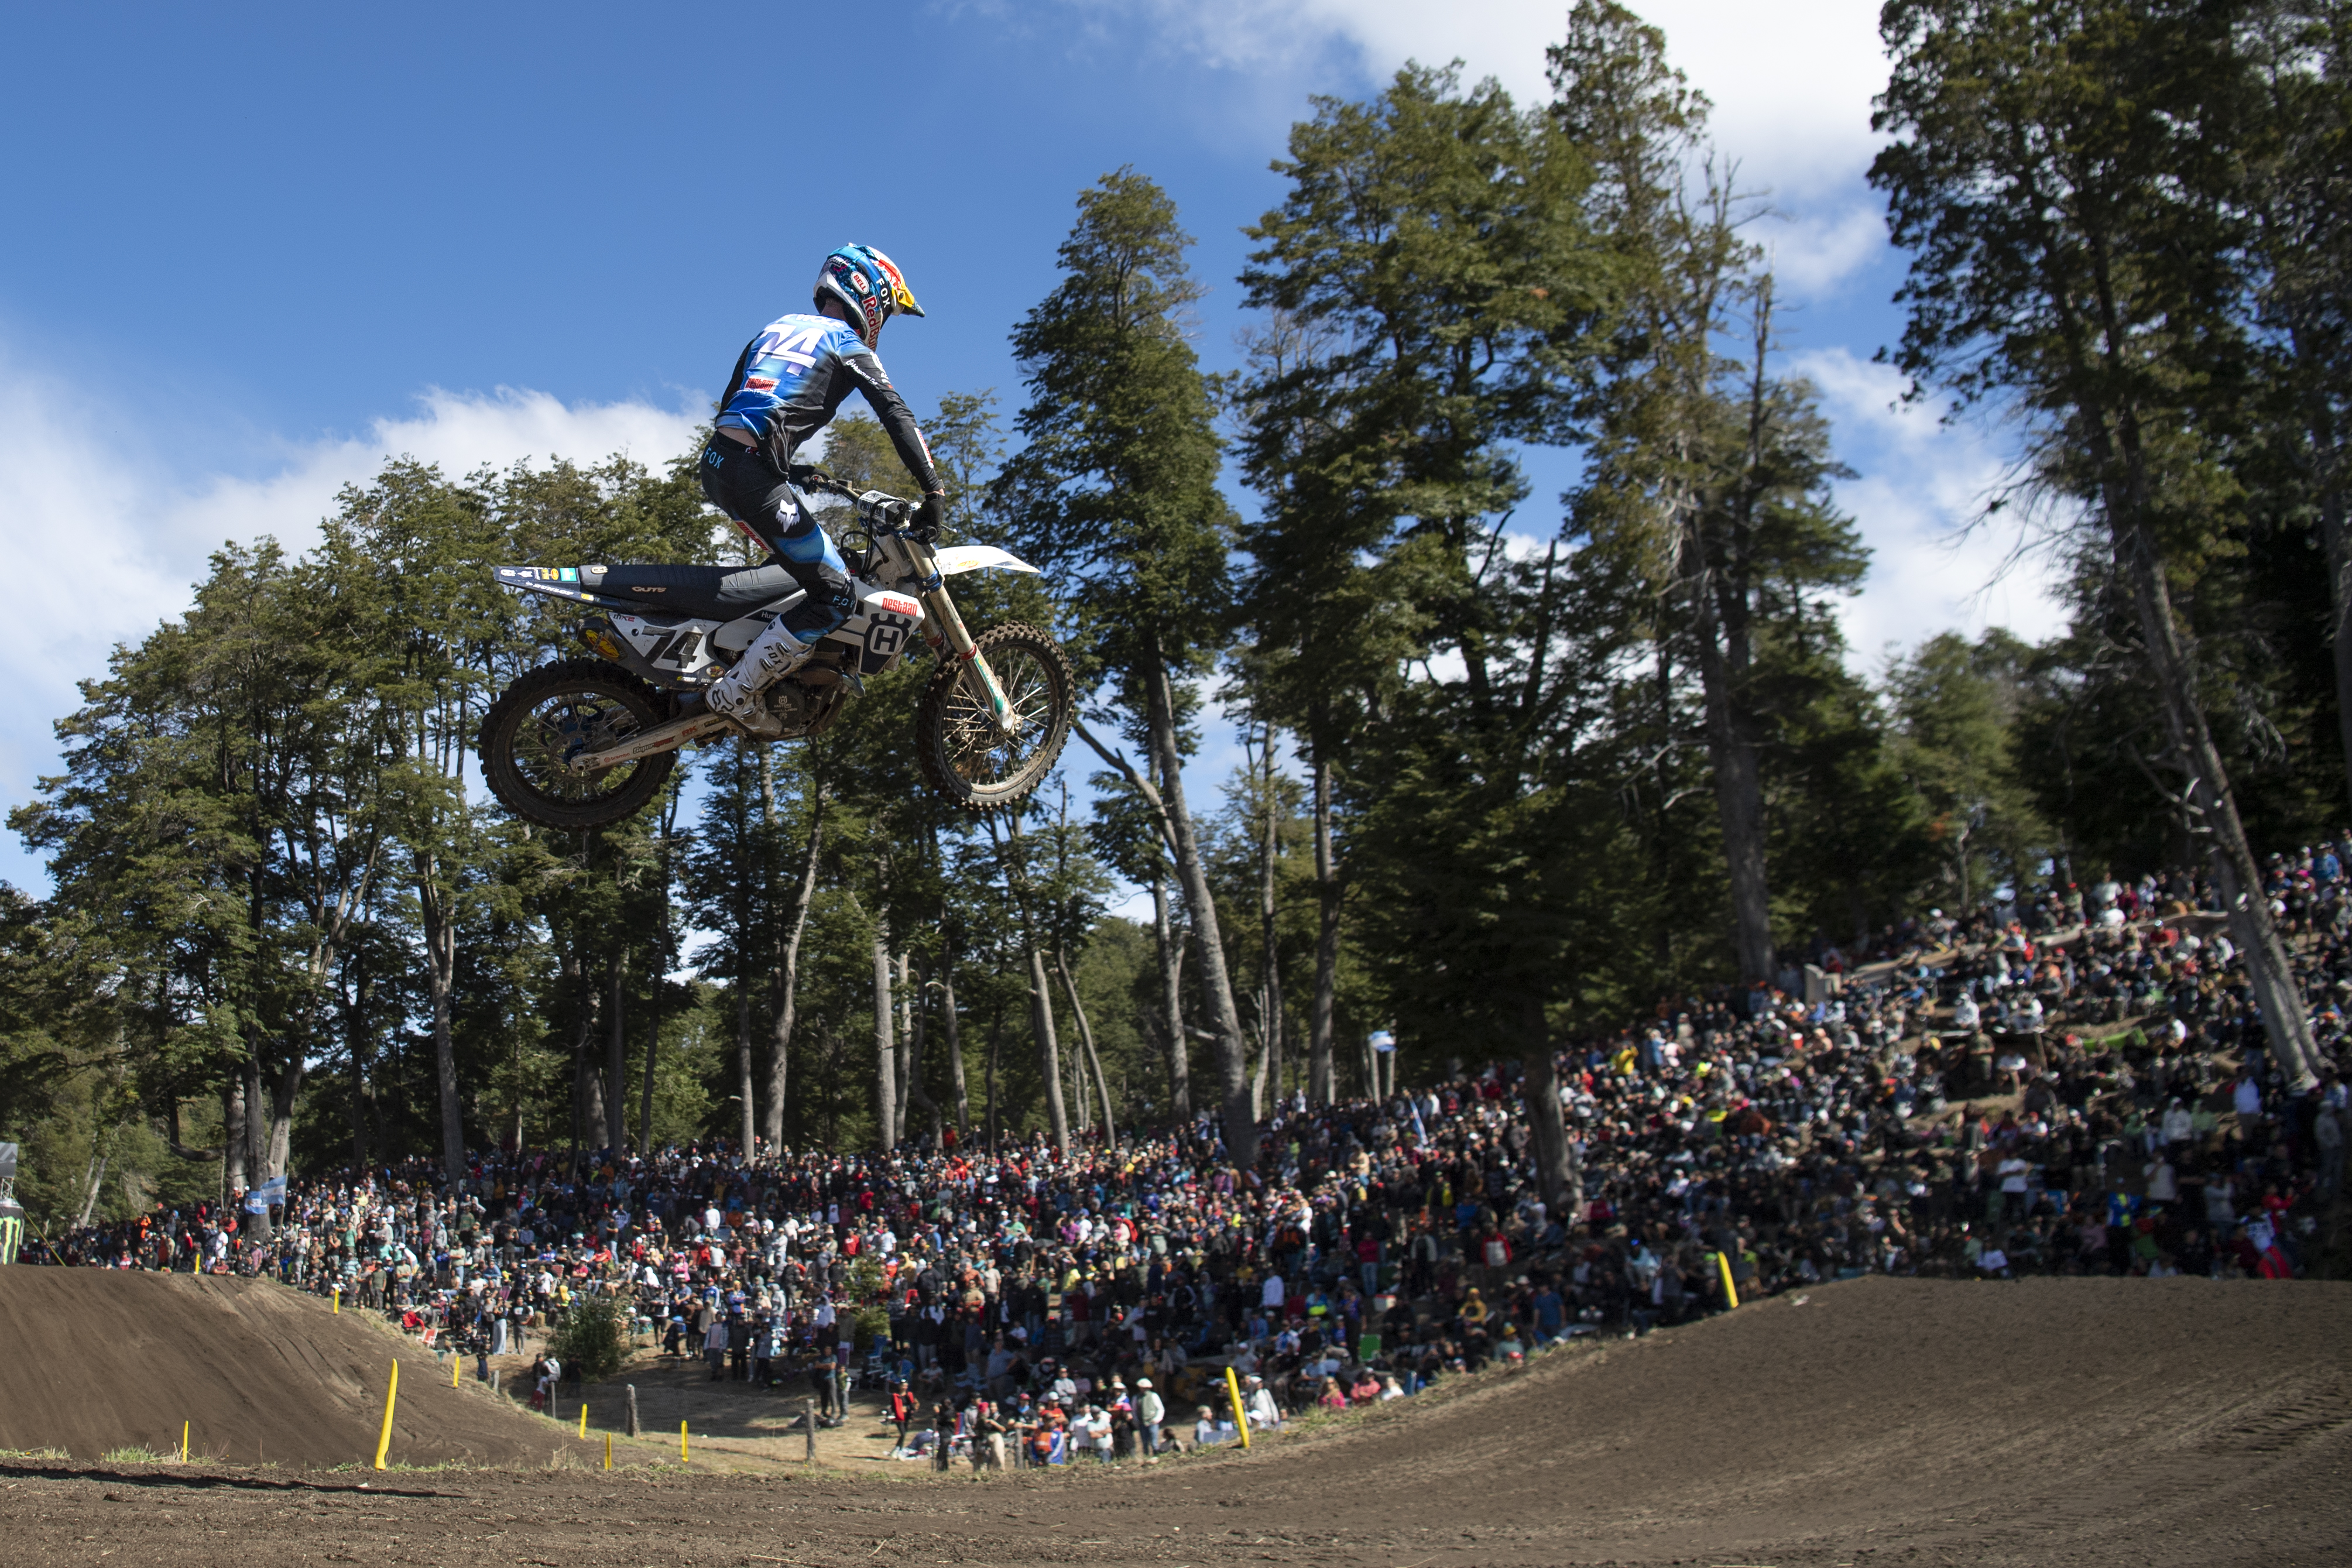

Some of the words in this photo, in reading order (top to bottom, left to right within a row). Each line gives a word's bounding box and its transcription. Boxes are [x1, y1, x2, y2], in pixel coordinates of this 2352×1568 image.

[853, 274, 867, 291] BELL
[876, 277, 891, 308] FOX
[862, 296, 882, 328] Red
[750, 324, 826, 376] 74
[704, 447, 725, 469] FOX
[533, 583, 574, 596] DUNLOP
[761, 612, 777, 620] Hus
[882, 597, 917, 617] nestaan
[642, 626, 704, 669] 74
[764, 645, 783, 665] FOX
[681, 726, 697, 737] RK
[611, 753, 630, 763] brembo
